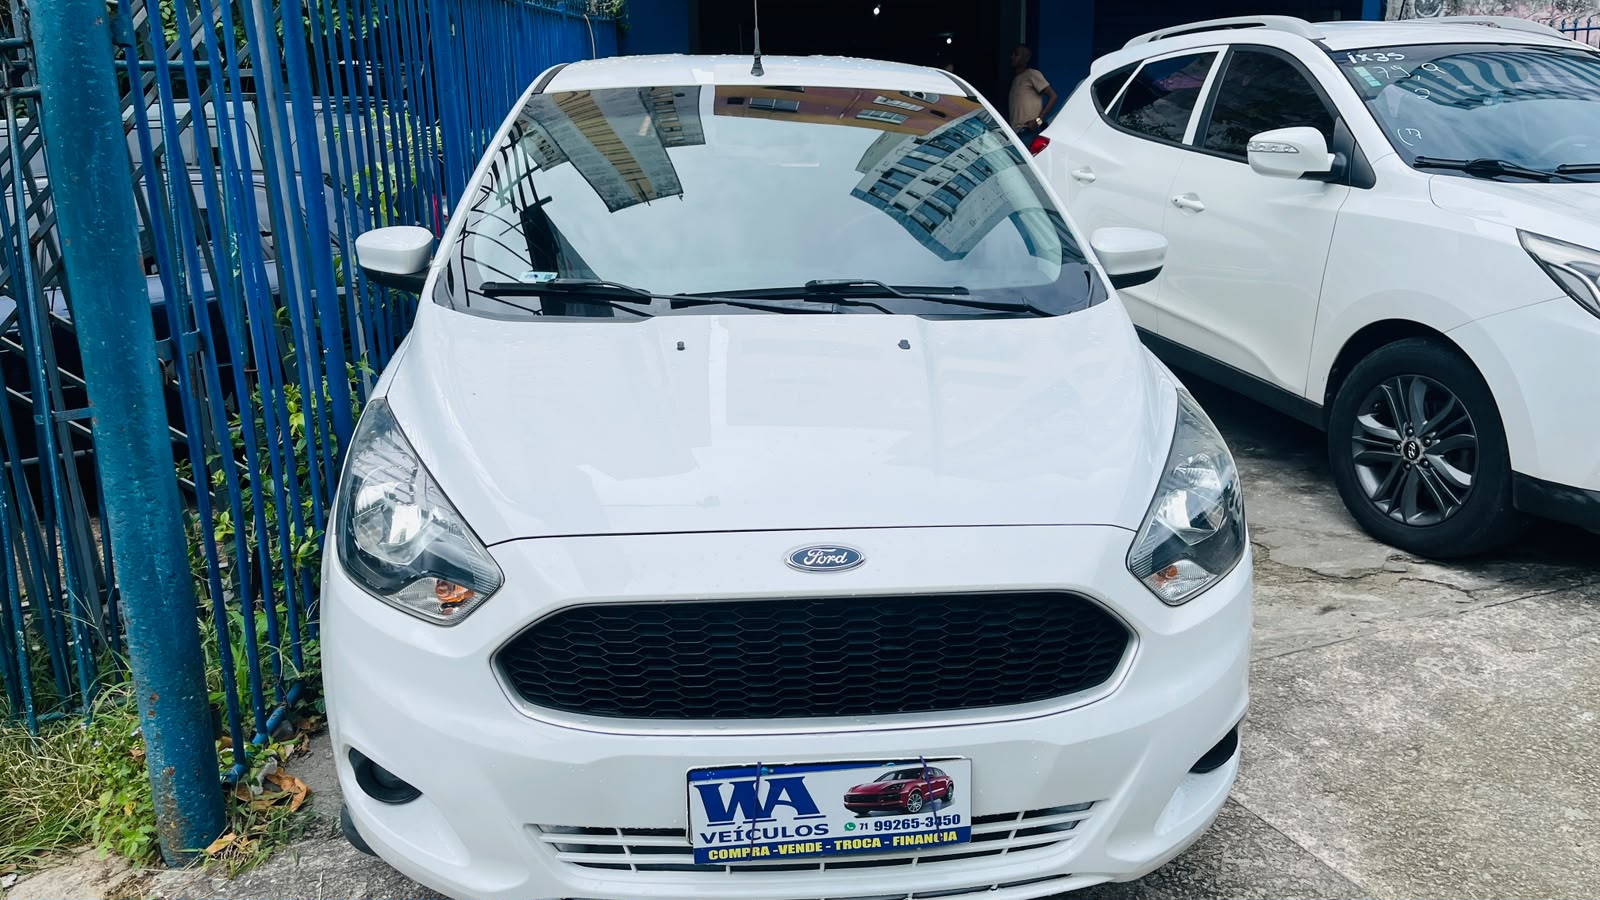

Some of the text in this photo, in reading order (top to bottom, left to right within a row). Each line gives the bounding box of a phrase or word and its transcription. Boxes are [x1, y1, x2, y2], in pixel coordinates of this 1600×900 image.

[803, 548, 848, 565] Ford
[692, 776, 821, 823] WA
[699, 823, 830, 844] VEÍCULOS
[859, 814, 961, 832] 71 99265-3450
[708, 845, 771, 860] COMPRA
[833, 837, 882, 851] TROCA
